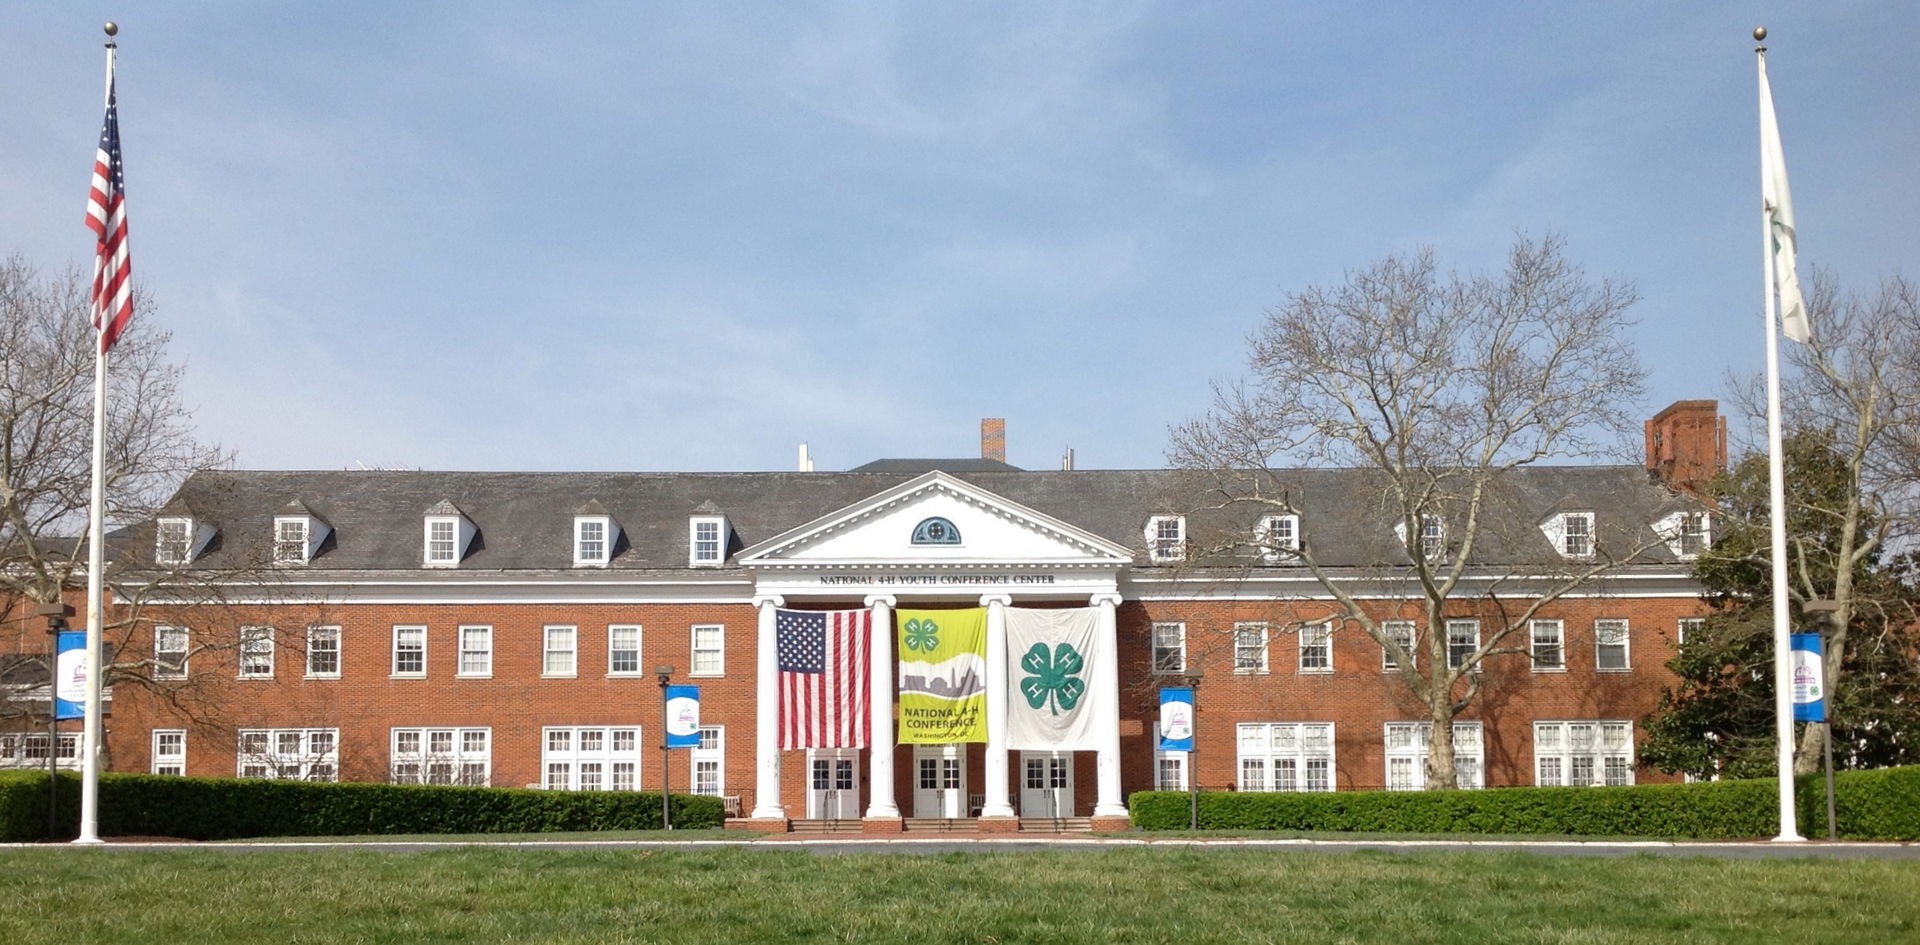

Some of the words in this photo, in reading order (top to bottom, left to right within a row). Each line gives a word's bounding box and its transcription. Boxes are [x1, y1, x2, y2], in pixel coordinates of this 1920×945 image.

[820, 575, 874, 585] NATIONAL
[899, 575, 937, 585] YOUTH
[940, 575, 1010, 585] CONFERENCE
[1013, 575, 1055, 585] CENTER
[1028, 652, 1045, 669] H
[1059, 652, 1075, 669] H
[1027, 682, 1043, 698] H
[1062, 682, 1077, 699] H
[905, 708, 960, 717] NATIONAL
[907, 718, 976, 728] CONFERENCE
